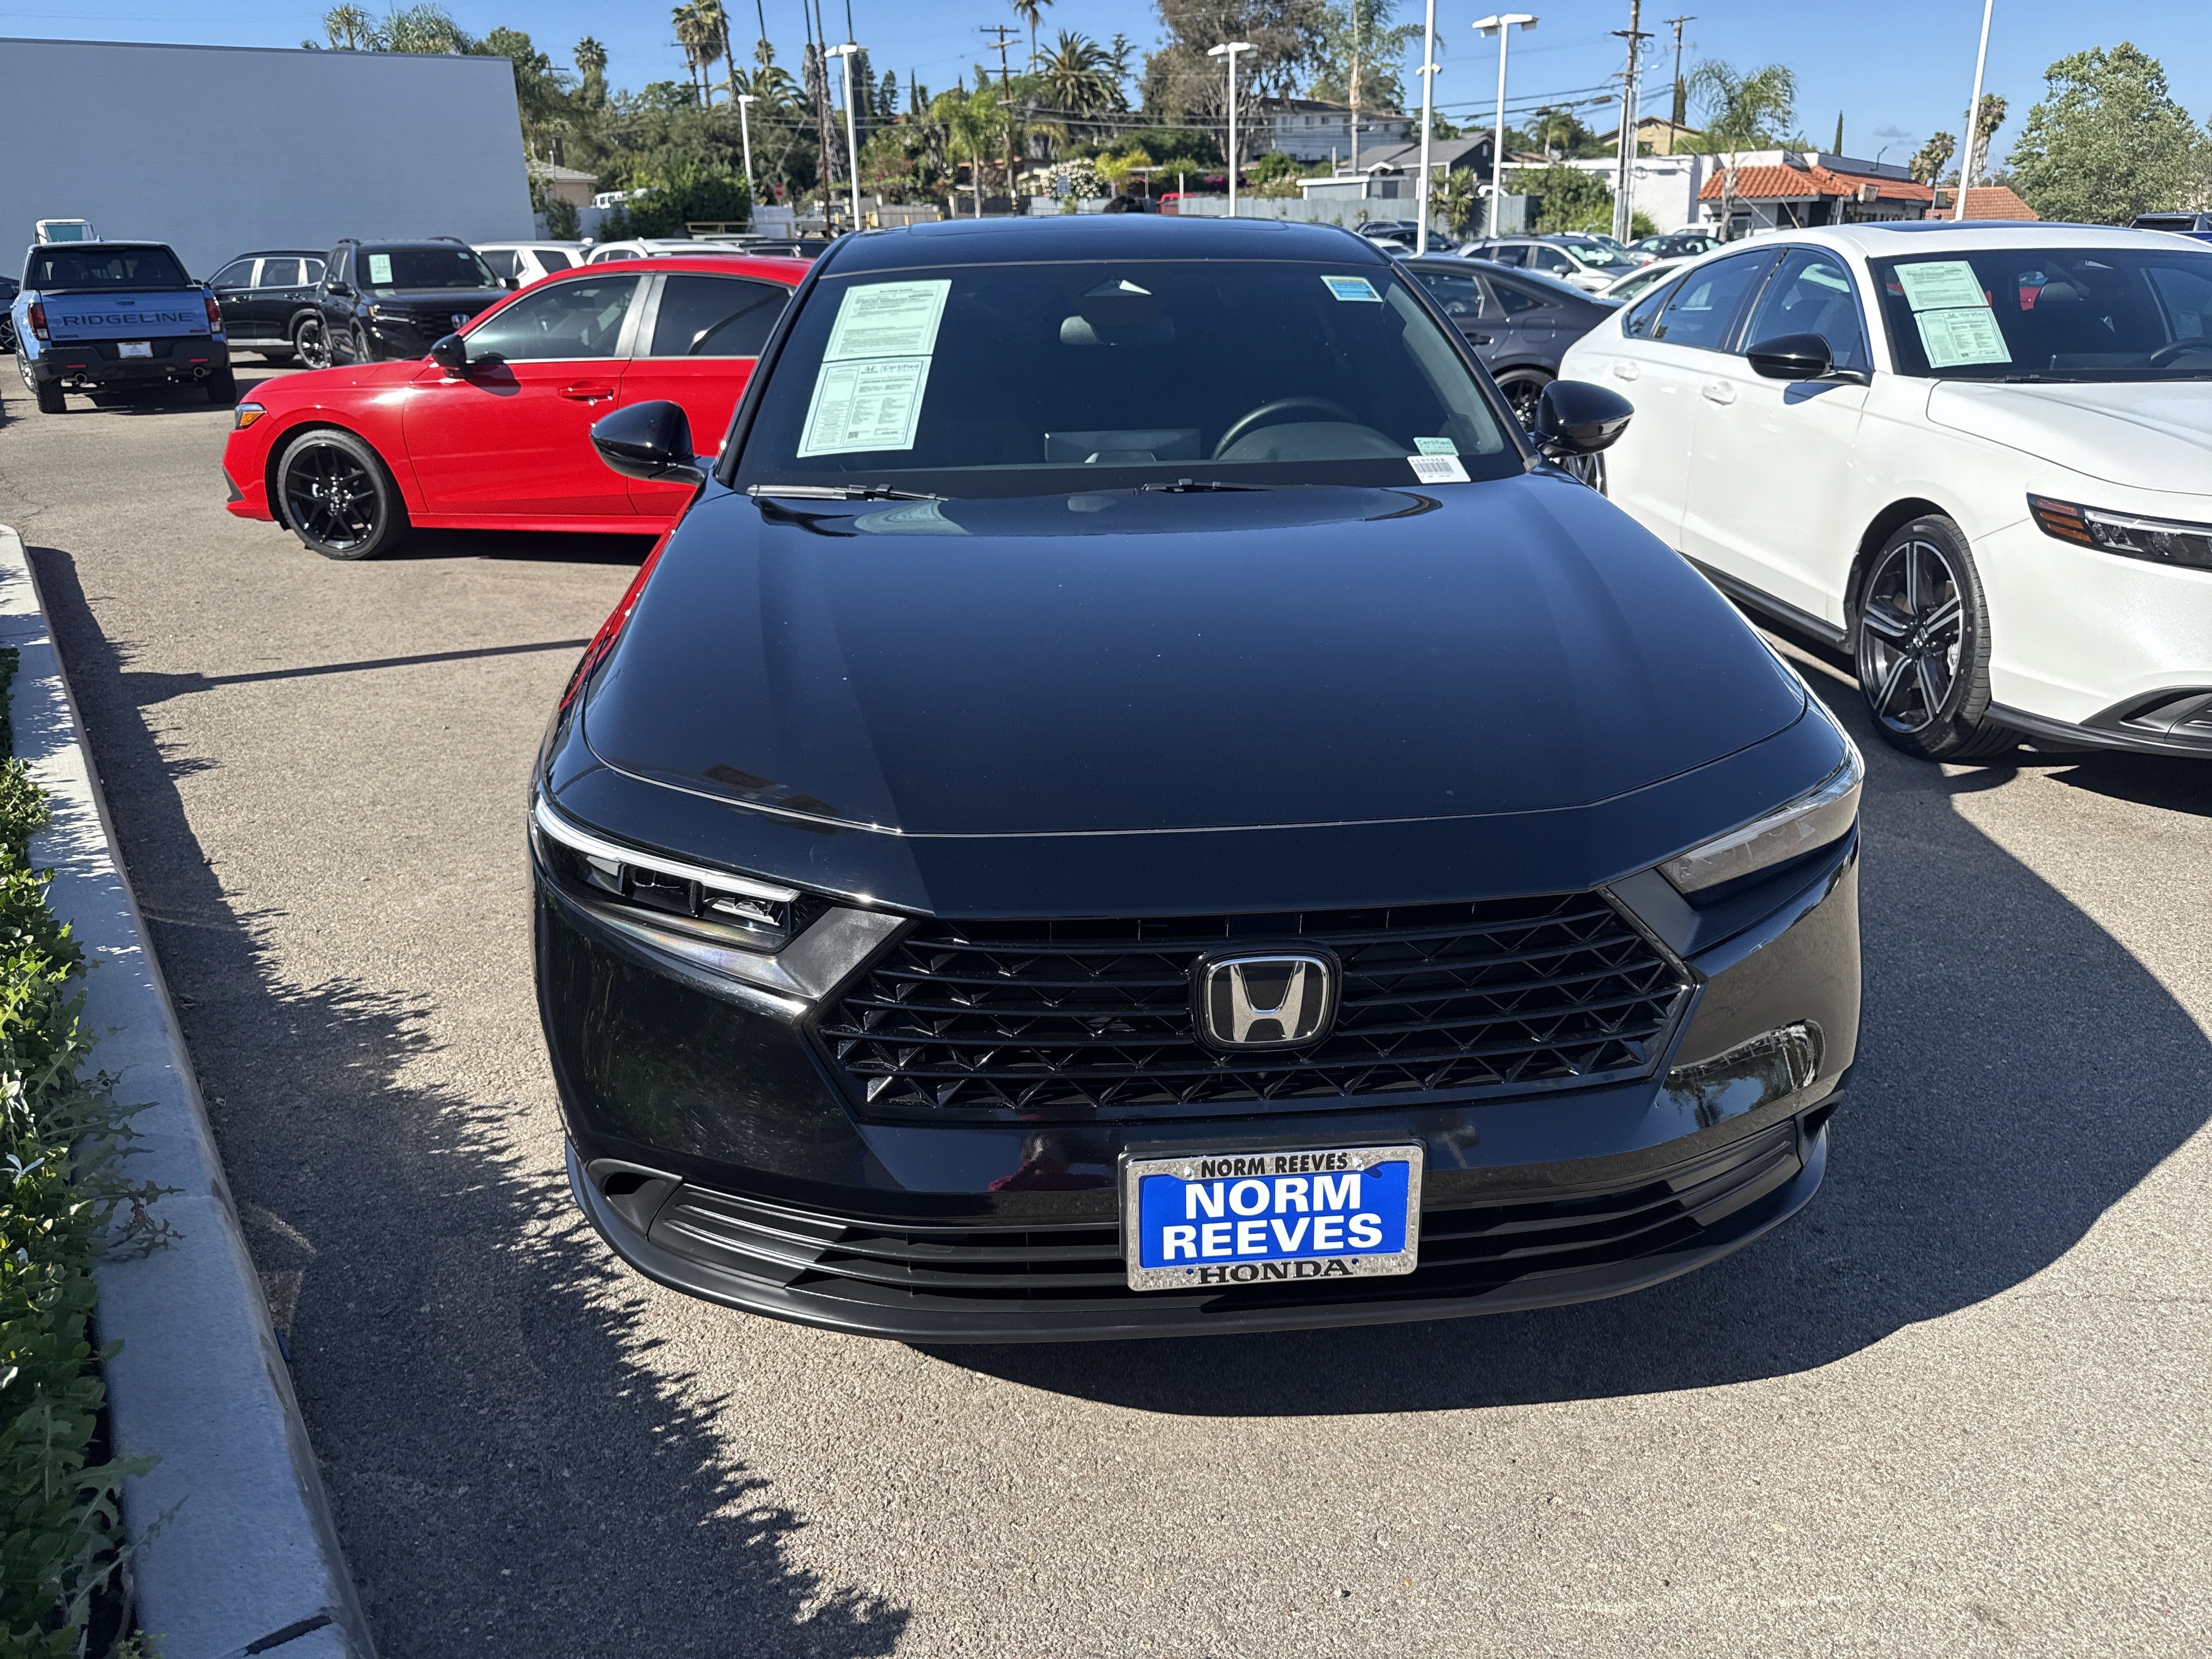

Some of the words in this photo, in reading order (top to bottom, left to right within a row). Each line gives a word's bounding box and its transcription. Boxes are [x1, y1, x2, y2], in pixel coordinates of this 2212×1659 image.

[63, 312, 193, 326] RIDGELINE
[1201, 1157, 1266, 1178] NORM
[1276, 1152, 1348, 1173] REEVES
[1186, 1175, 1361, 1219] NORM
[1163, 1213, 1383, 1260] REEVES
[1199, 1259, 1353, 1284] HONDA
